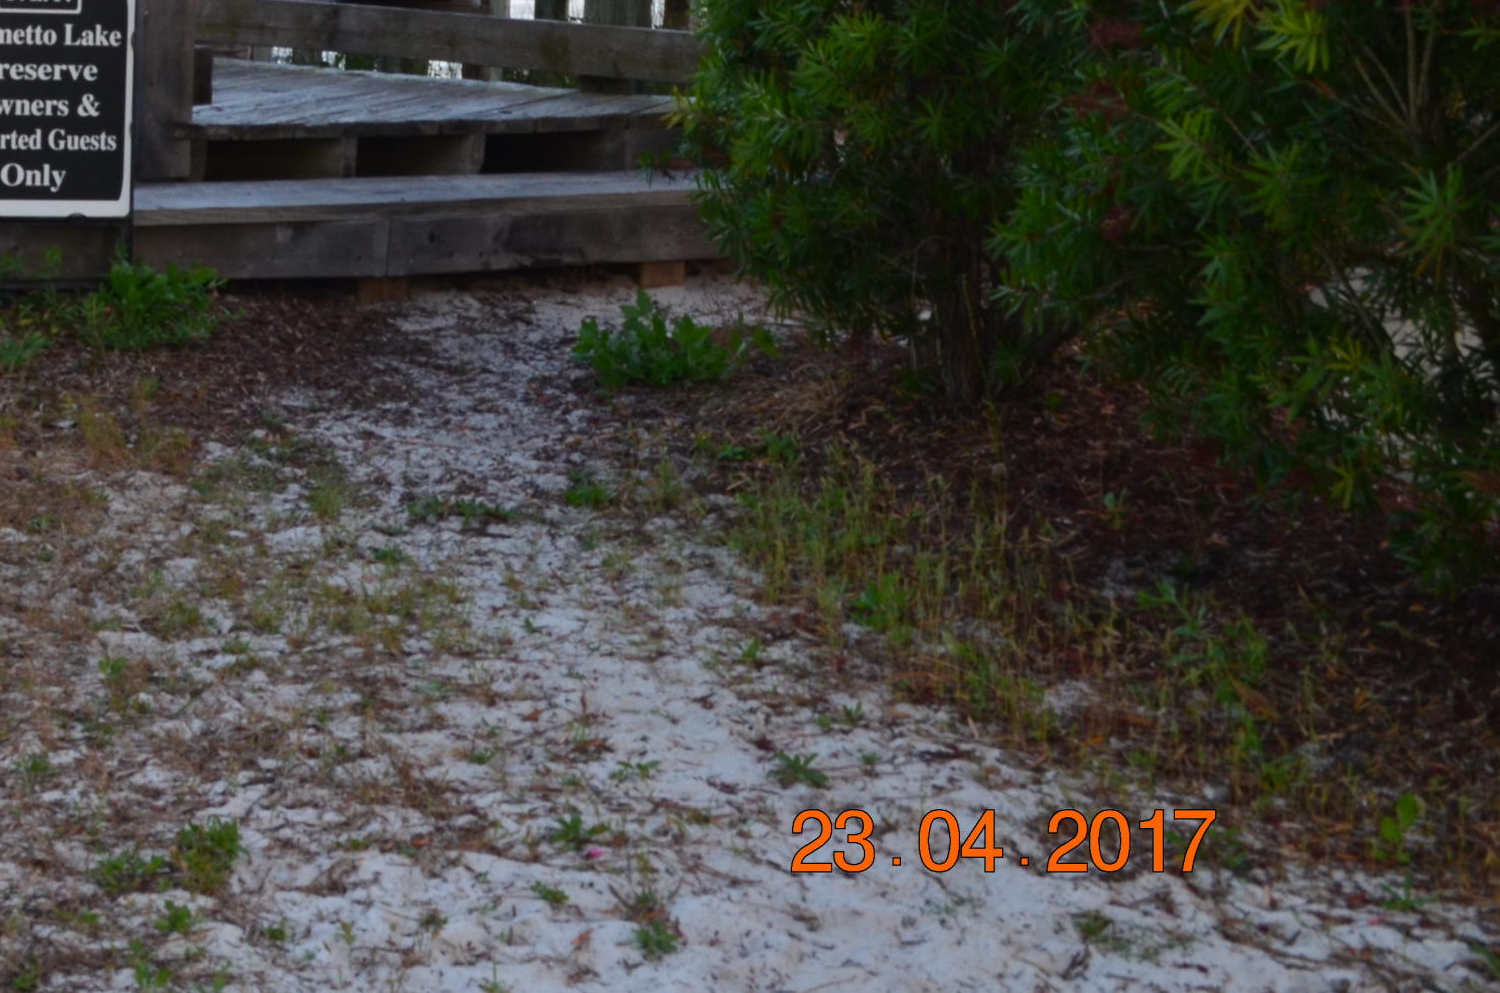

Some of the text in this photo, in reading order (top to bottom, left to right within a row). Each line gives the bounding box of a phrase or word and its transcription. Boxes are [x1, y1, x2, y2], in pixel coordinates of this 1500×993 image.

[64, 24, 121, 46] Lake
[77, 94, 100, 116] &
[48, 129, 116, 150] Guests
[0, 163, 66, 192] Only
